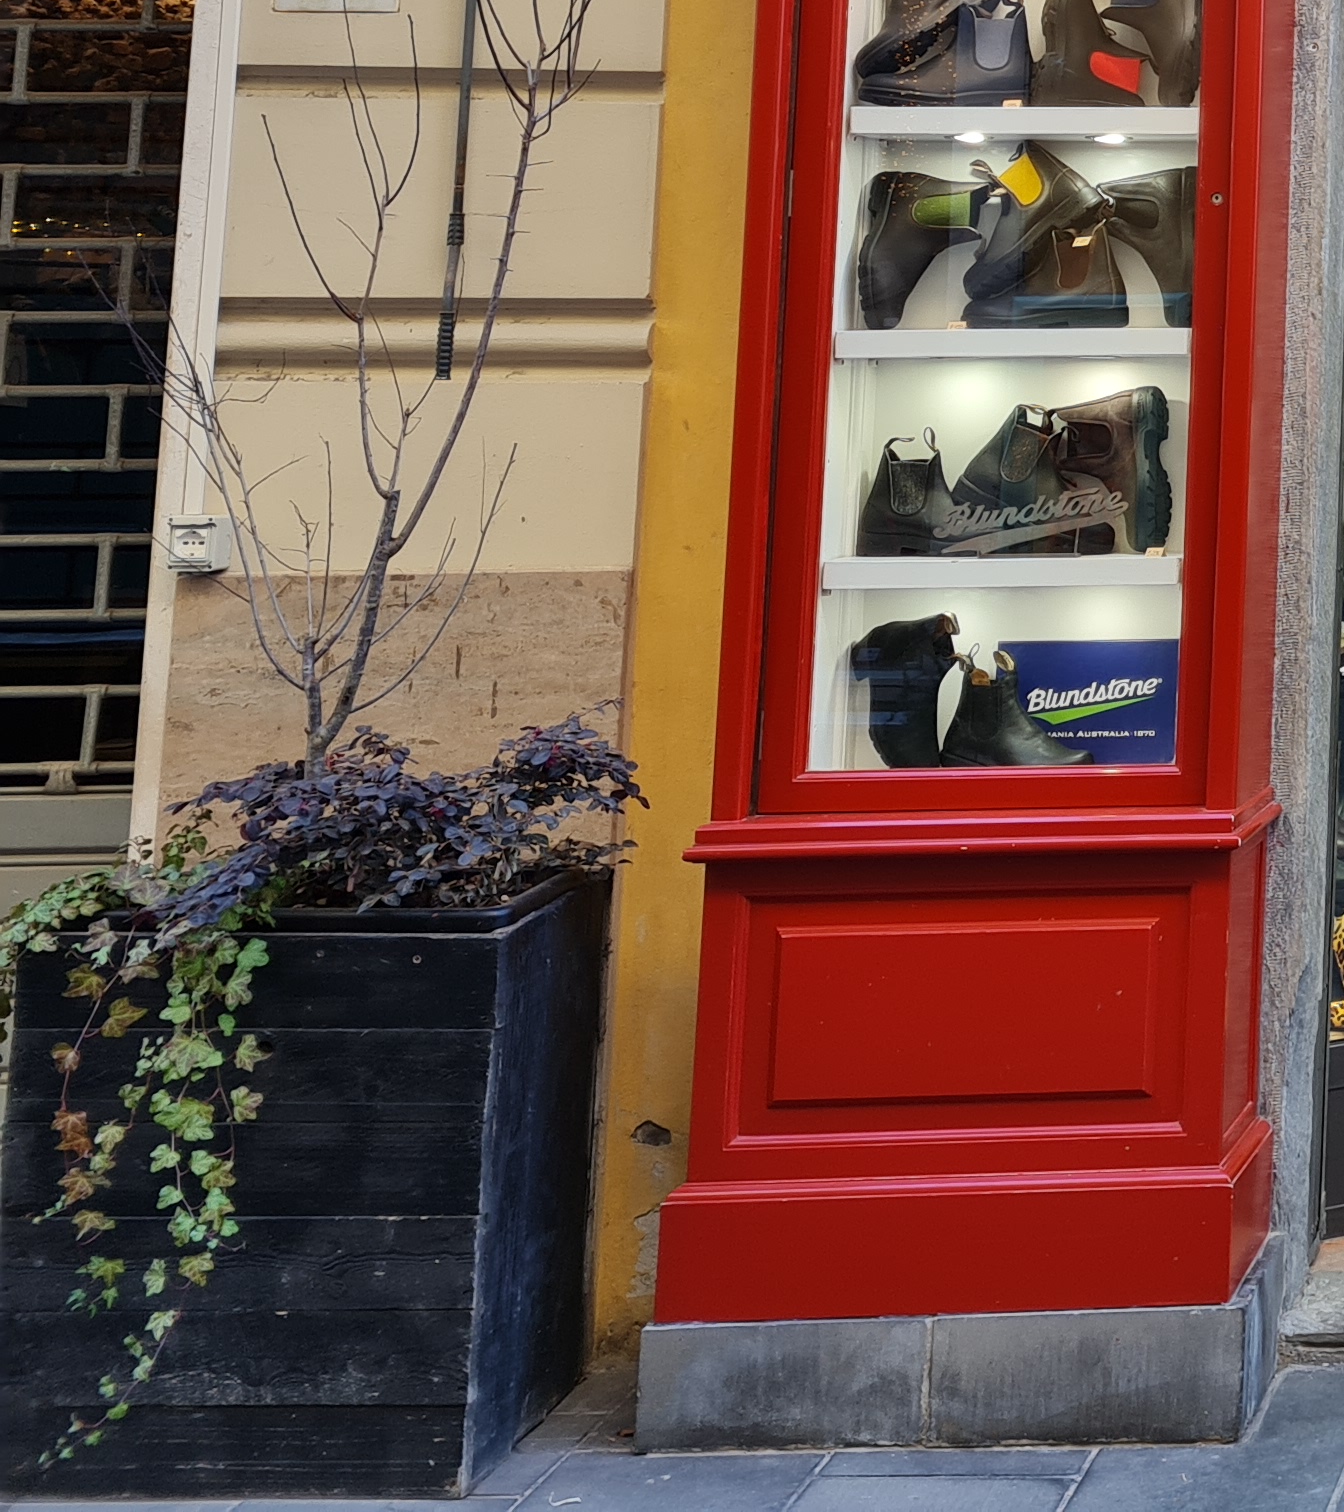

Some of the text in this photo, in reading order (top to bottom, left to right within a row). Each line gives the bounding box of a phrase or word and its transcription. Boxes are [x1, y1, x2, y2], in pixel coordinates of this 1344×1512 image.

[933, 488, 1129, 538] Blundstone
[1026, 677, 1159, 713] Blundstone
[1047, 730, 1074, 738] ANIA
